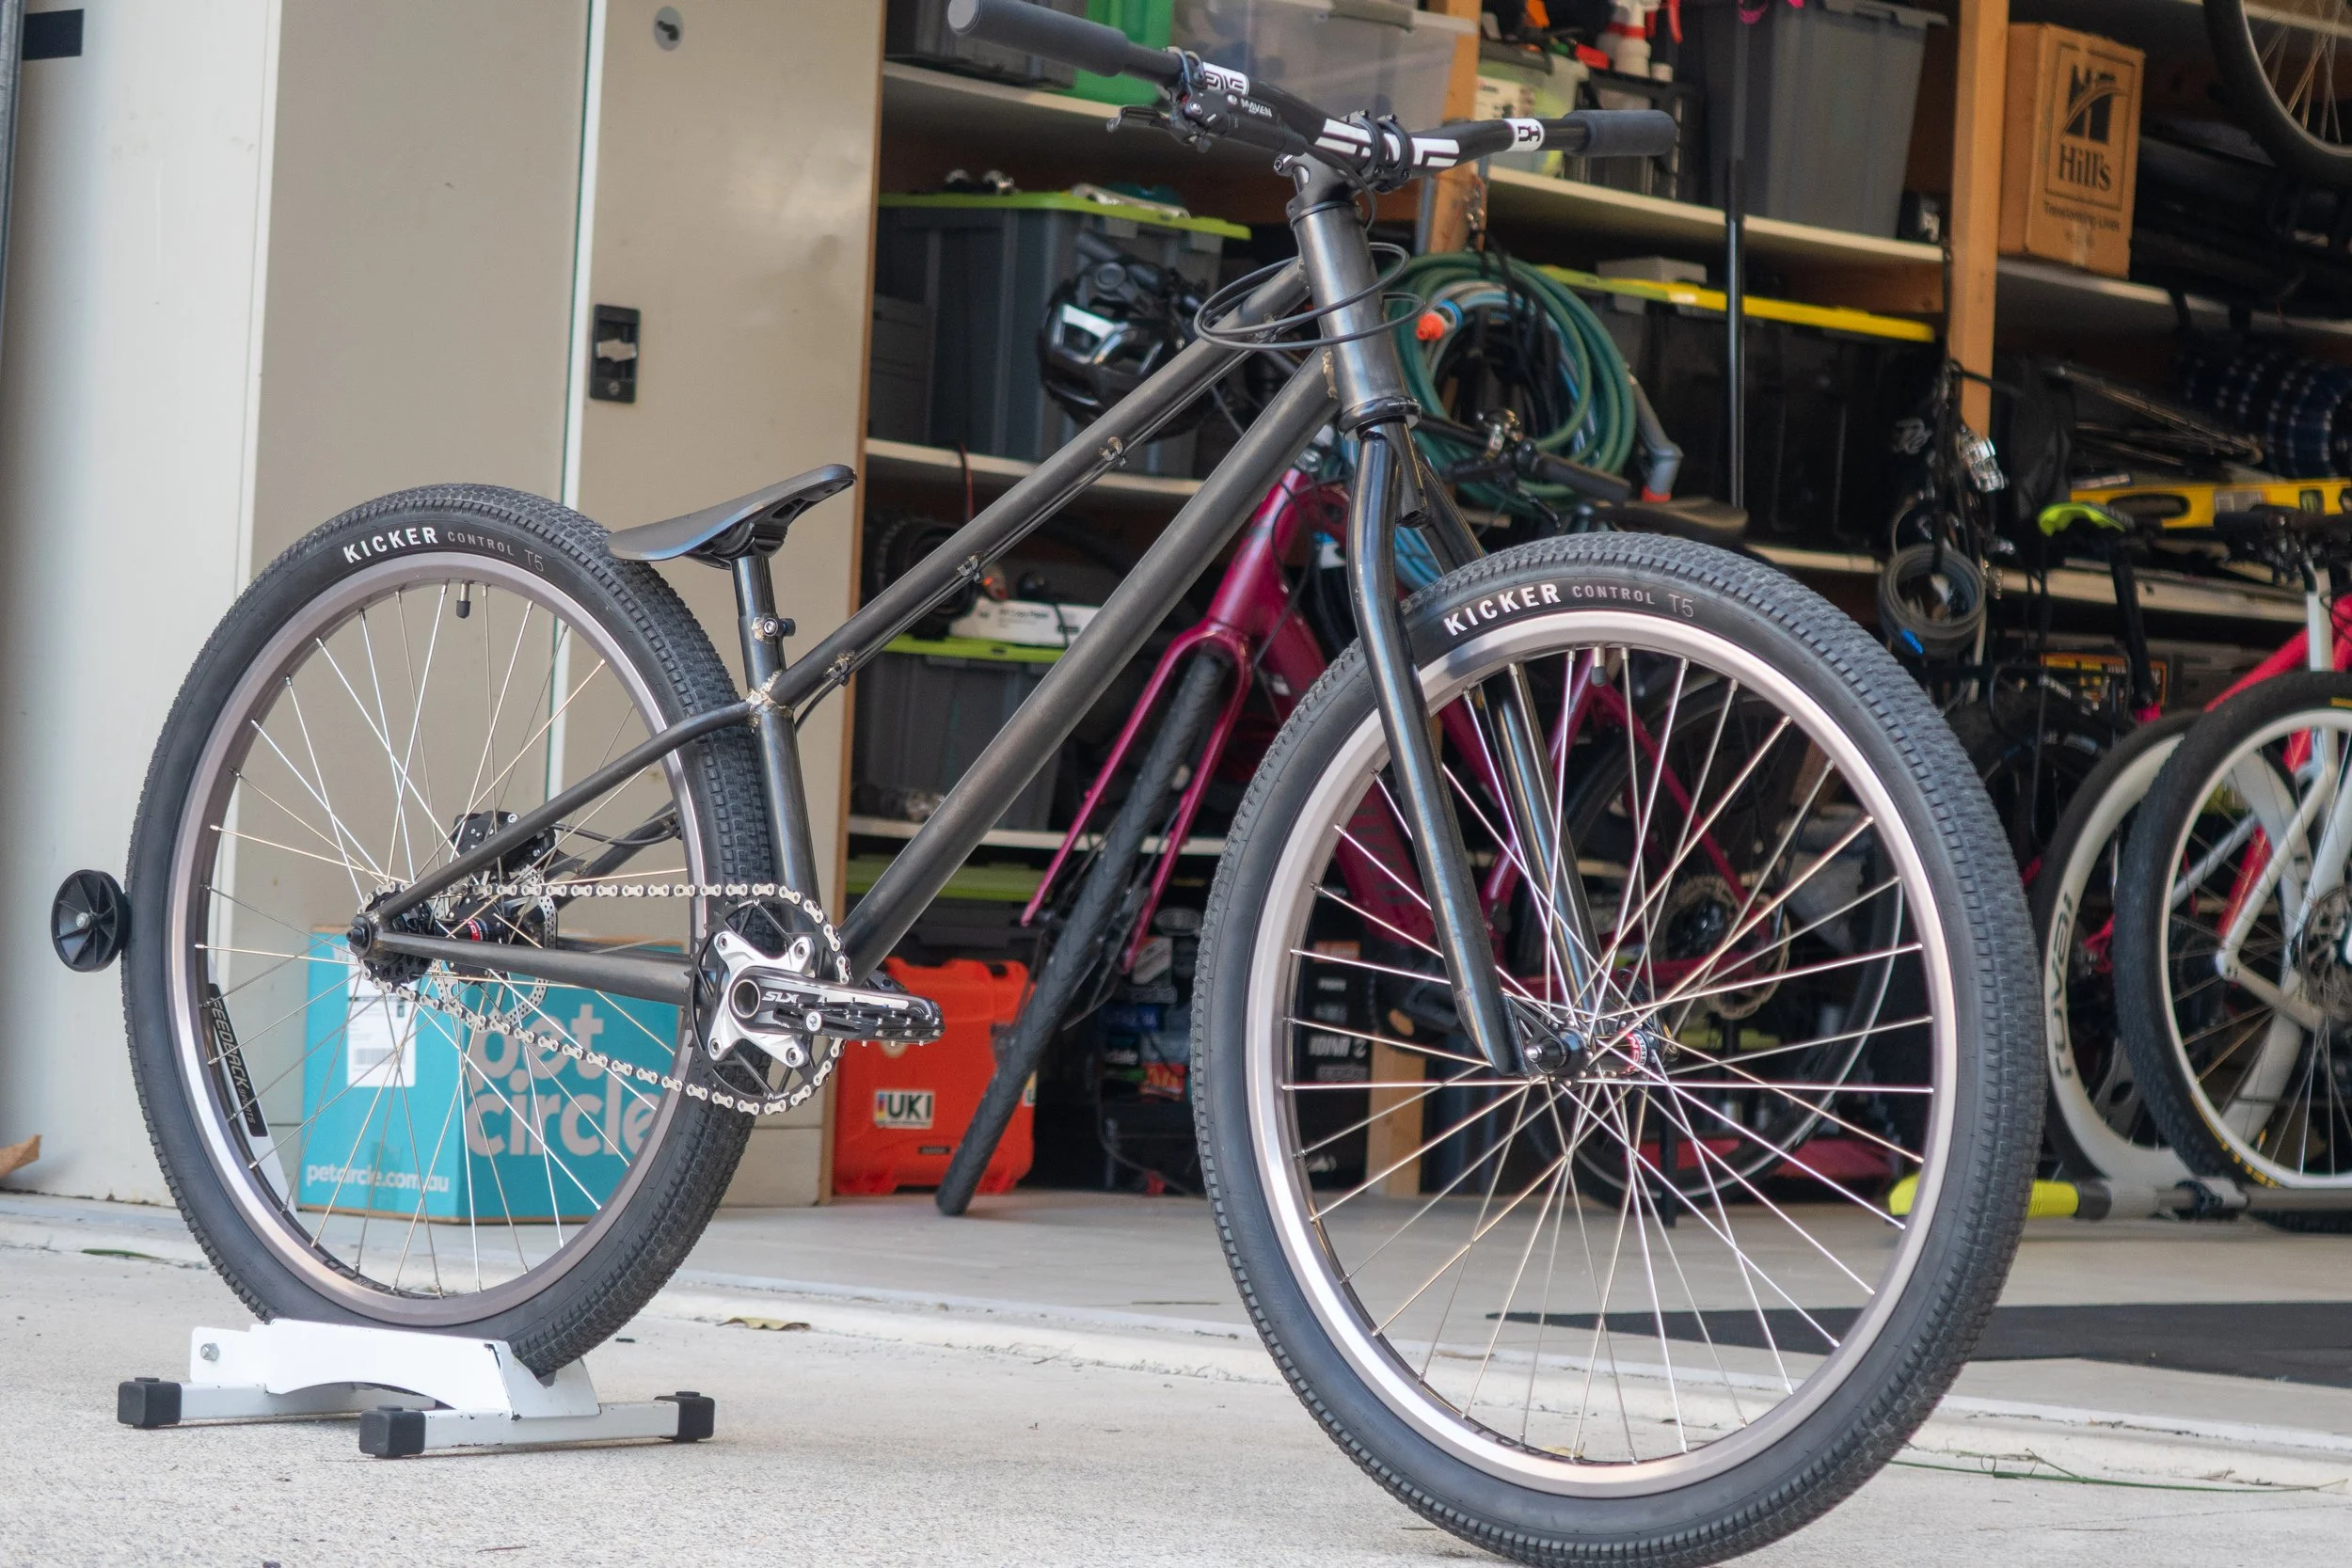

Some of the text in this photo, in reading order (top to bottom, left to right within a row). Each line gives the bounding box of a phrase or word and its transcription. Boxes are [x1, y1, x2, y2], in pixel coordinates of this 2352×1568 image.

[1240, 98, 1273, 118] MAVEN
[2058, 143, 2112, 192] Hill's
[342, 526, 545, 573] KICKER CONTROL T5
[1442, 583, 1694, 637] KICKER CONTROL T5
[761, 990, 800, 1004] SLX
[209, 996, 257, 1125] FEEDBACK SPORTS
[468, 1003, 604, 1097] pet
[887, 1094, 933, 1120] UKI
